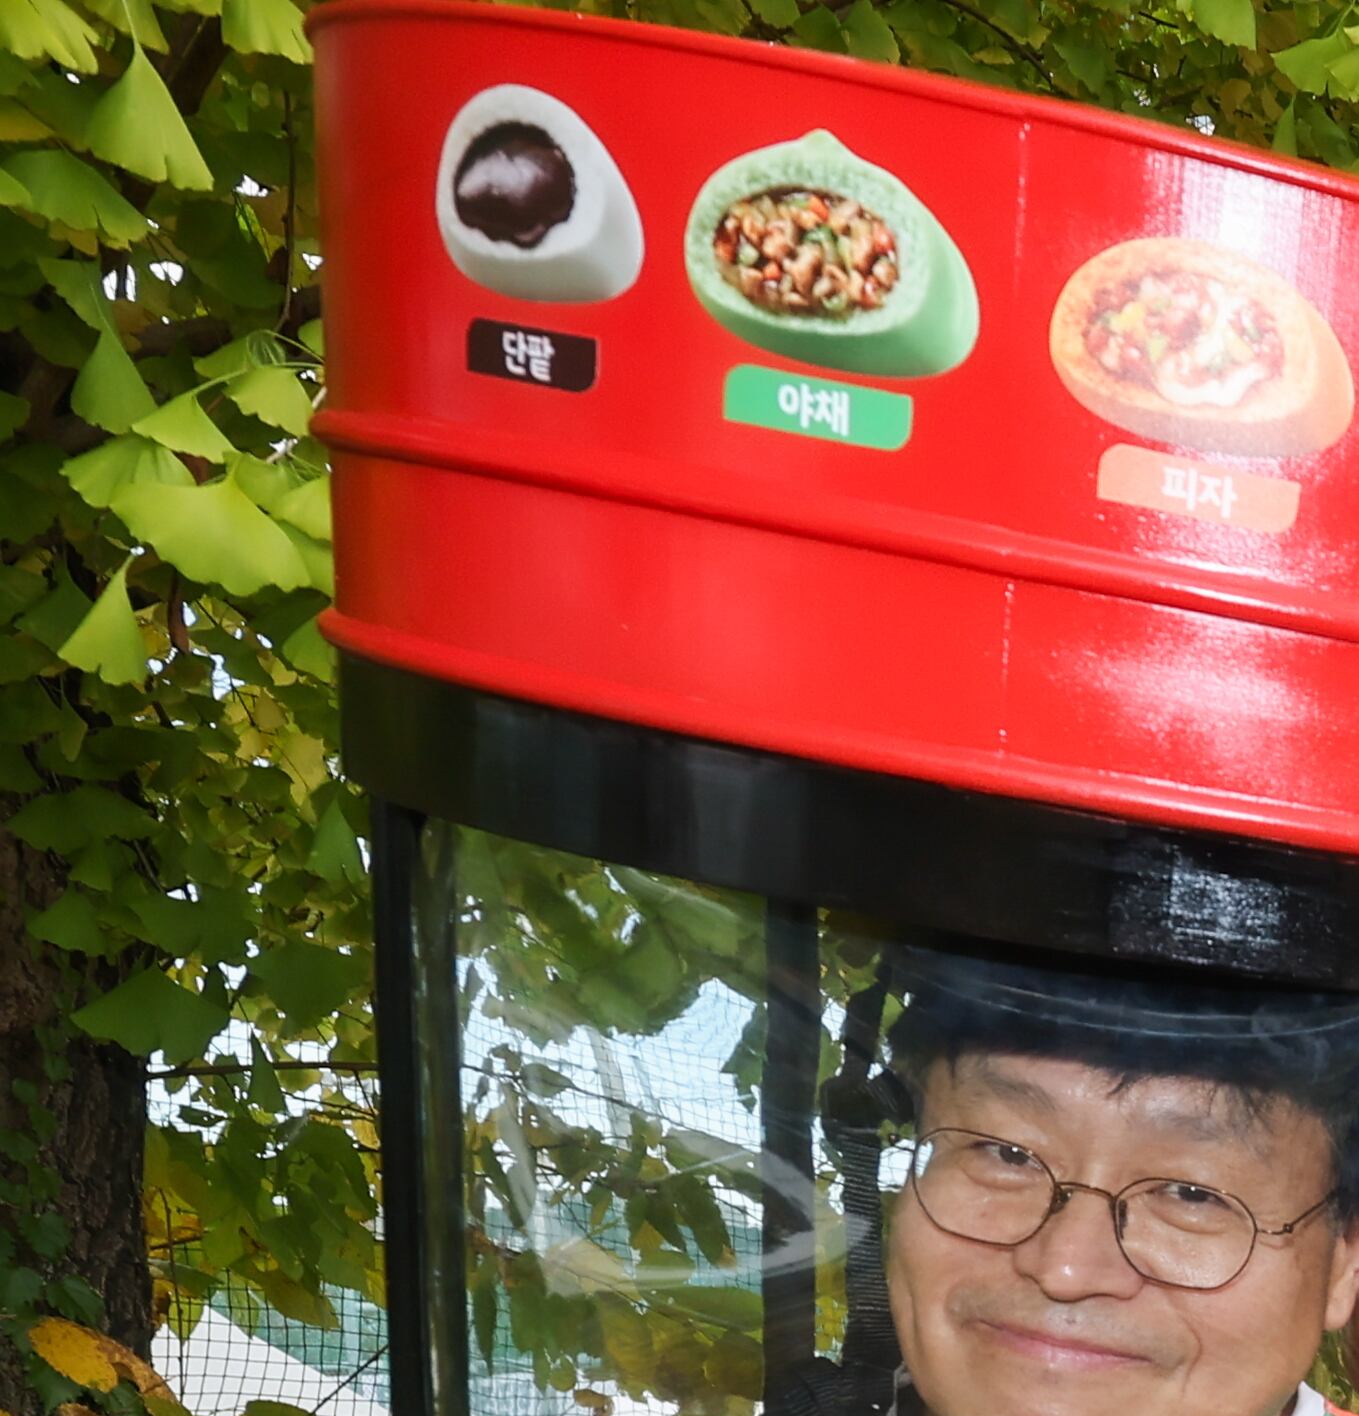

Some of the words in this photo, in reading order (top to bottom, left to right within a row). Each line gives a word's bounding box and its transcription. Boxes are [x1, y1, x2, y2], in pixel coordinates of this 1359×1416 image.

[502, 331, 555, 382] 단팥
[777, 383, 849, 436] 야채
[1161, 466, 1238, 518] 피자
